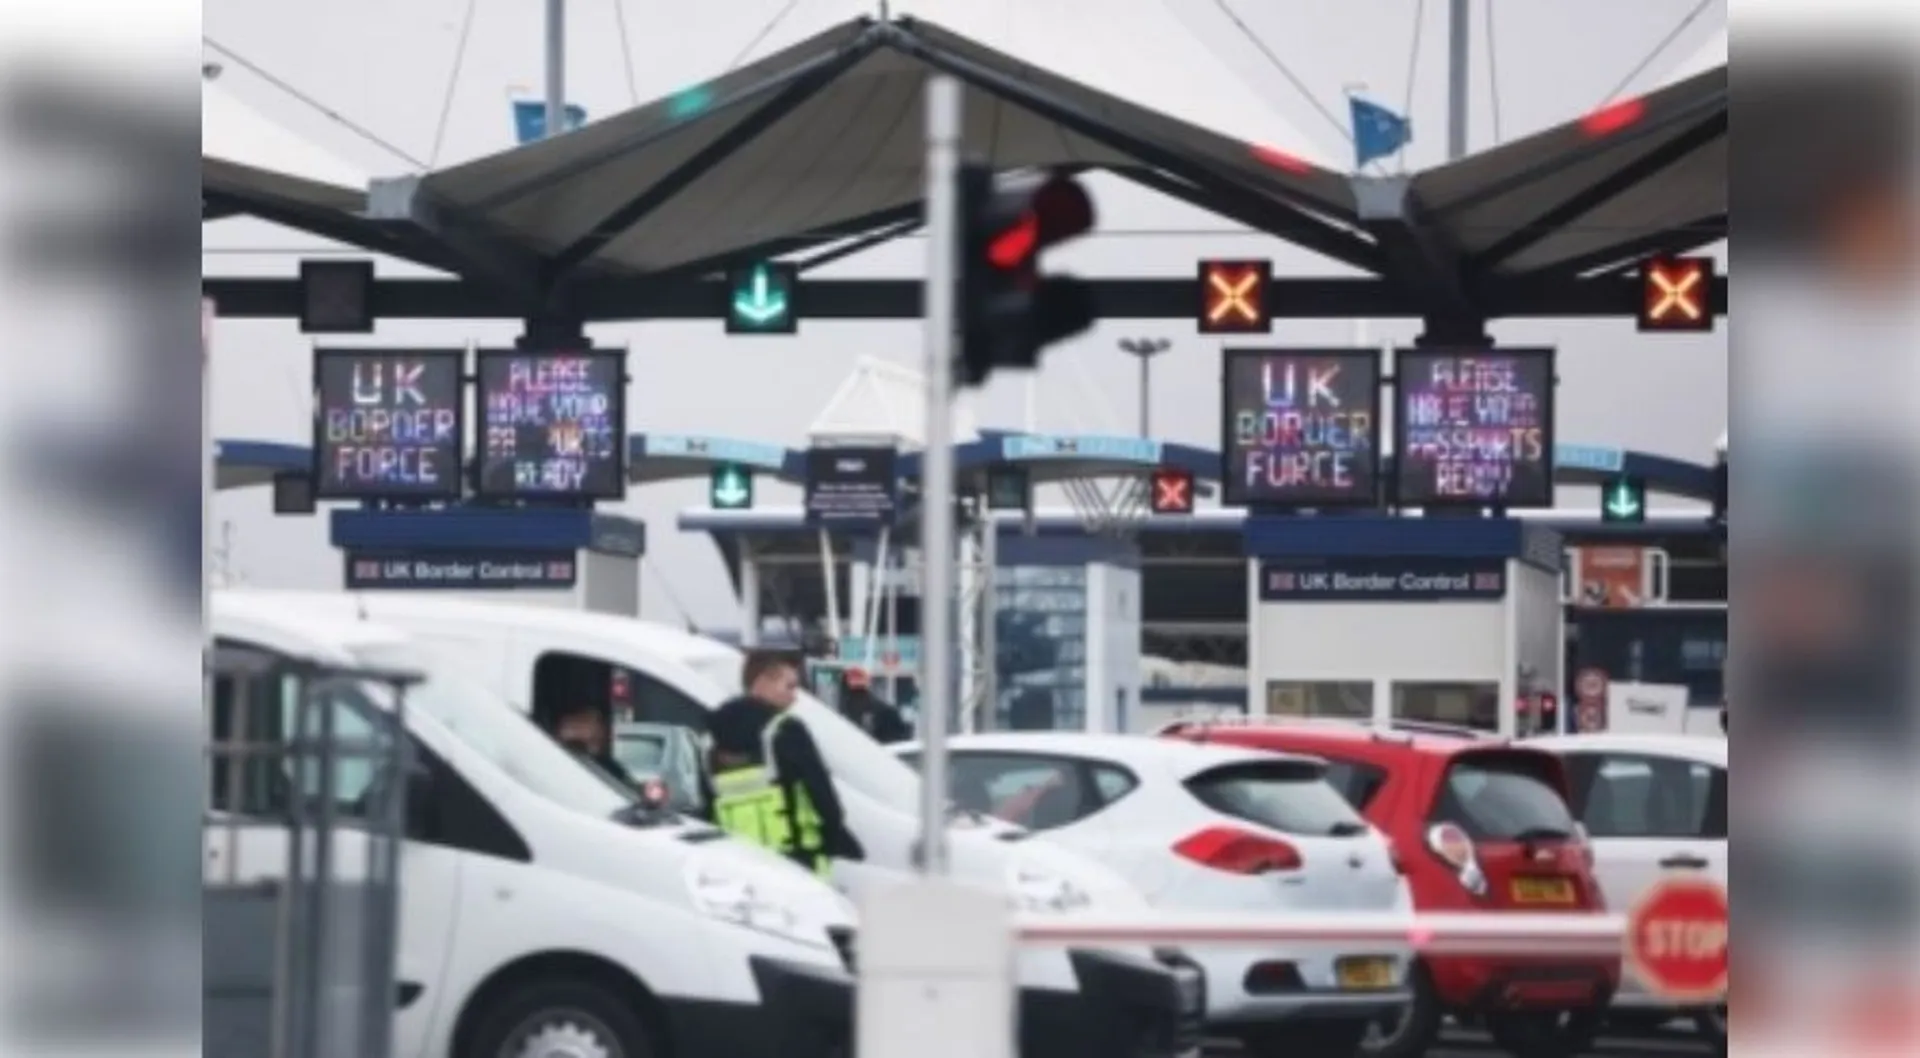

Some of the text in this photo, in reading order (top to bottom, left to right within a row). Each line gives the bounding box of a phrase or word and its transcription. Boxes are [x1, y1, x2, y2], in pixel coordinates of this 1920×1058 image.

[351, 362, 425, 404] UK
[1262, 362, 1341, 407] UK
[327, 408, 455, 442] BORDER
[1236, 411, 1370, 448] BORDER
[337, 446, 438, 482] FORCE
[384, 560, 543, 580] UK Border Control
[1301, 572, 1470, 591] UK Border Control
[1645, 917, 1727, 959] STOP
